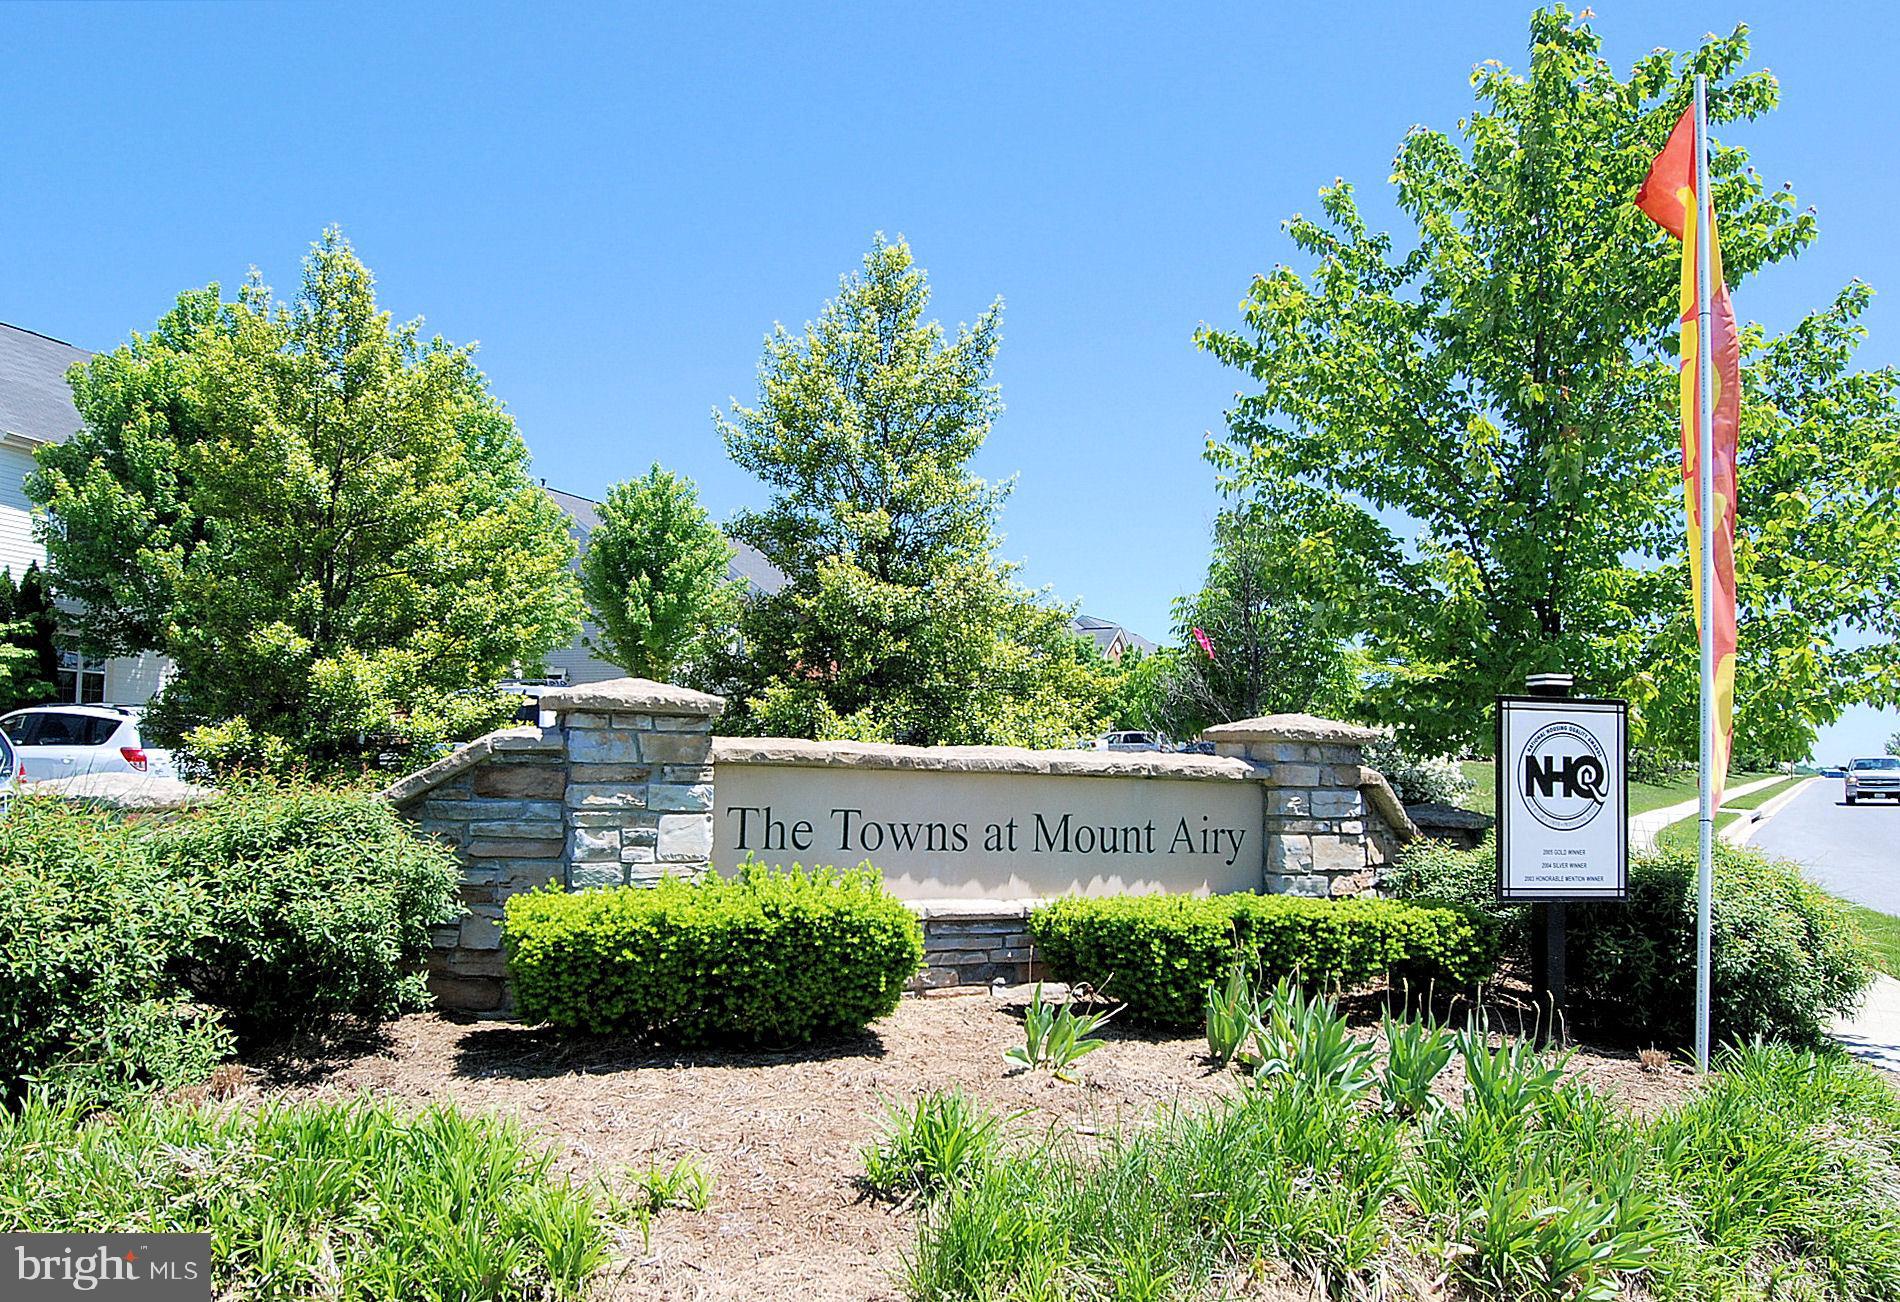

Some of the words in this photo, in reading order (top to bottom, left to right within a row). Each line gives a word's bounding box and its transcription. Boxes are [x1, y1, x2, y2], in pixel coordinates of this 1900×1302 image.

[1527, 732, 1546, 753] NATIONAL
[1546, 725, 1568, 734] HOUSING
[1569, 726, 1589, 739] QUALITY
[1525, 755, 1606, 806] NHQ
[726, 806, 813, 852] The
[830, 808, 969, 853] Towns
[984, 814, 1018, 853] at
[1031, 812, 1156, 855] Mount
[1167, 814, 1247, 866] Airy
